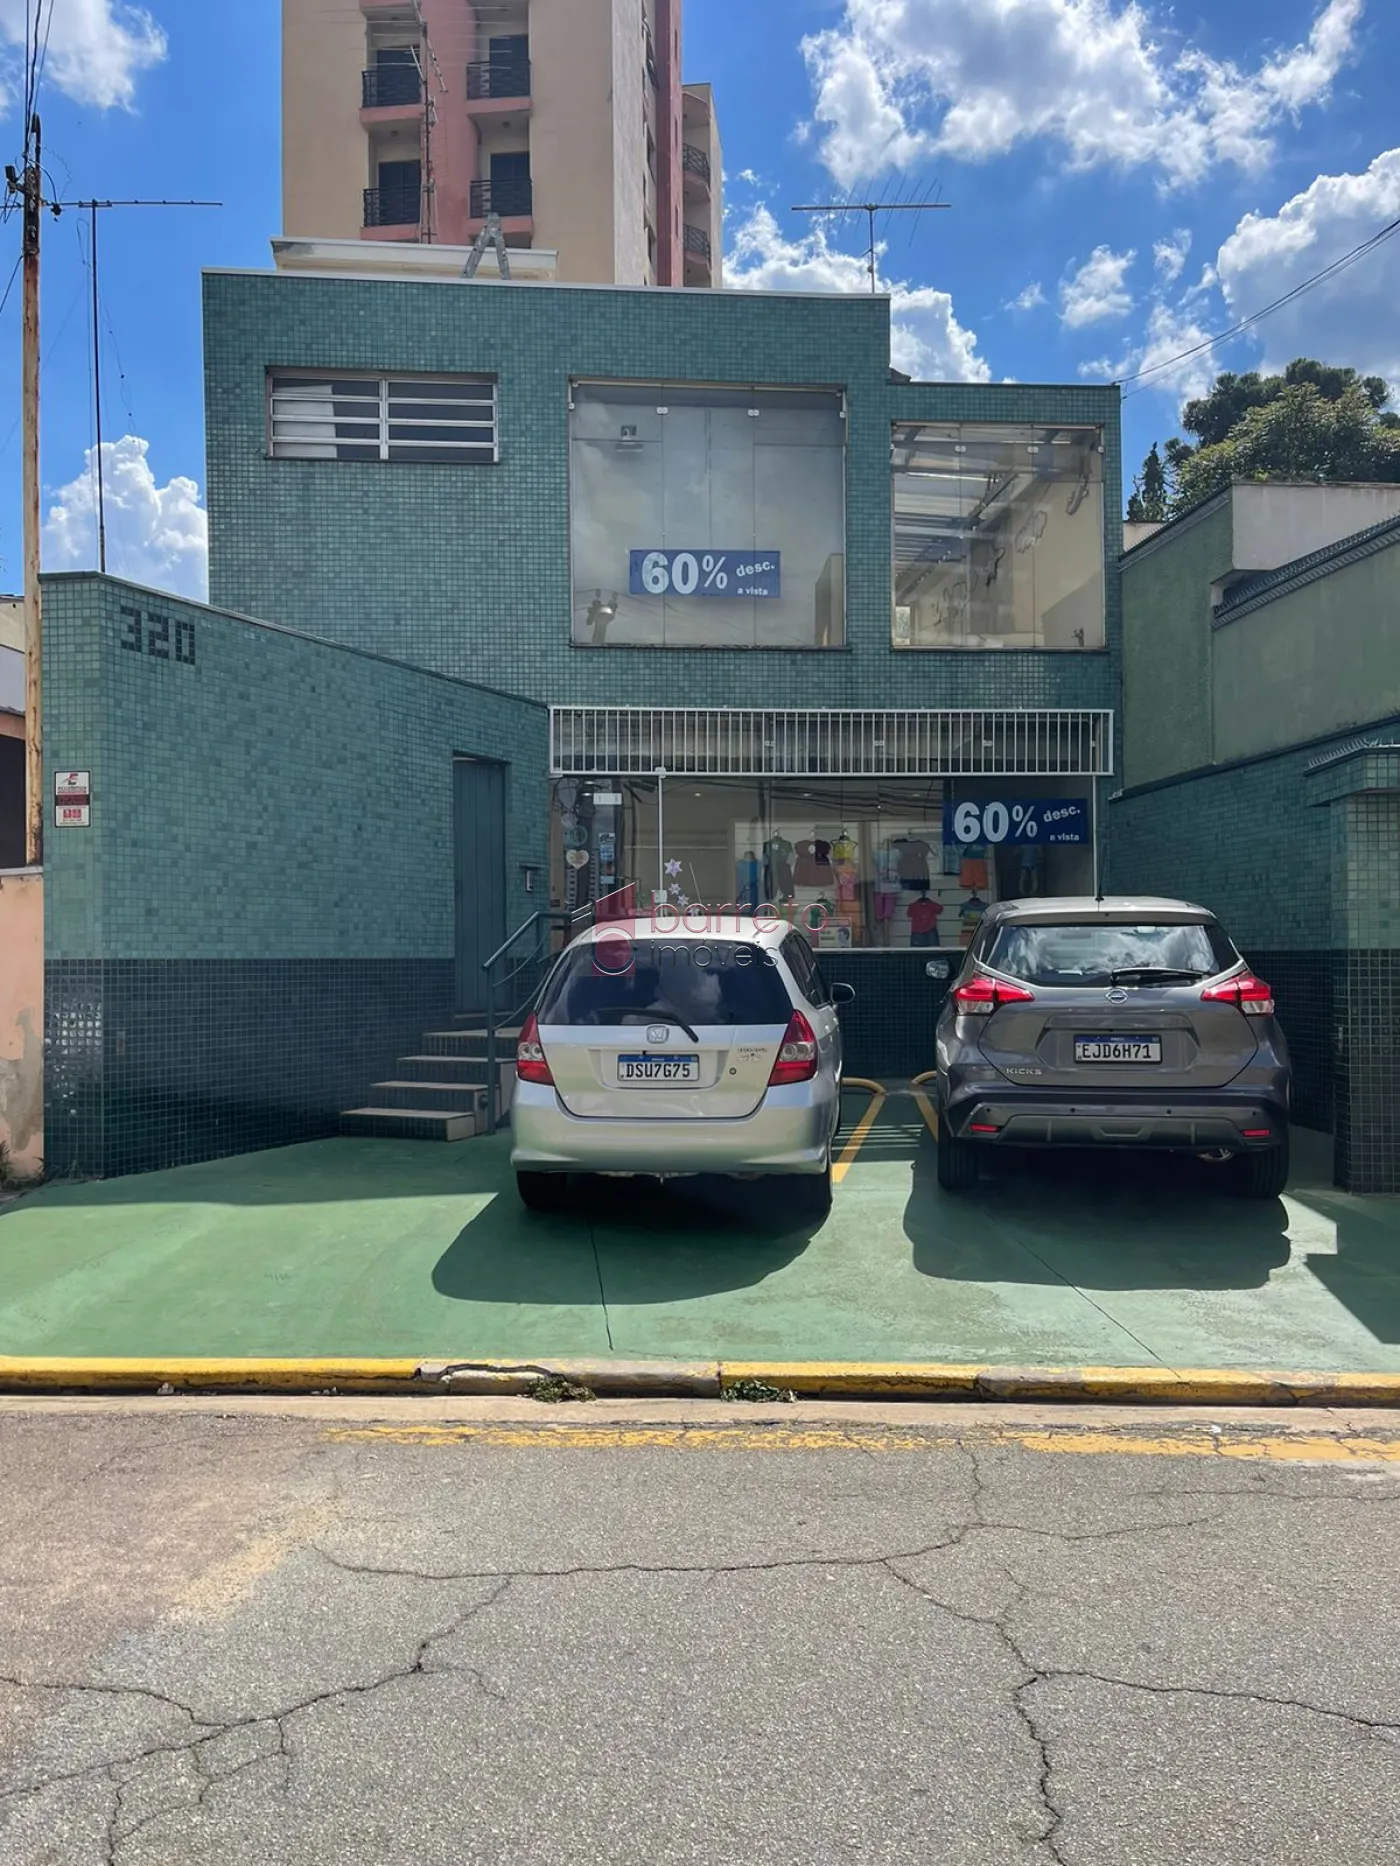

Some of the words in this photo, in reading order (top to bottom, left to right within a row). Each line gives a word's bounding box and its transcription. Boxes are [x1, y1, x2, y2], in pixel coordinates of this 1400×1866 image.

[642, 552, 728, 595] 60%
[736, 561, 775, 577] desc.
[745, 586, 769, 596] vista
[120, 605, 196, 666] 320
[953, 801, 1038, 843] 60%
[1043, 804, 1081, 823] desc.
[1057, 832, 1080, 841] vista
[1082, 1043, 1152, 1059] EJD6H71
[626, 1063, 691, 1078] DSU7G75
[1006, 1067, 1042, 1075] KICKS
